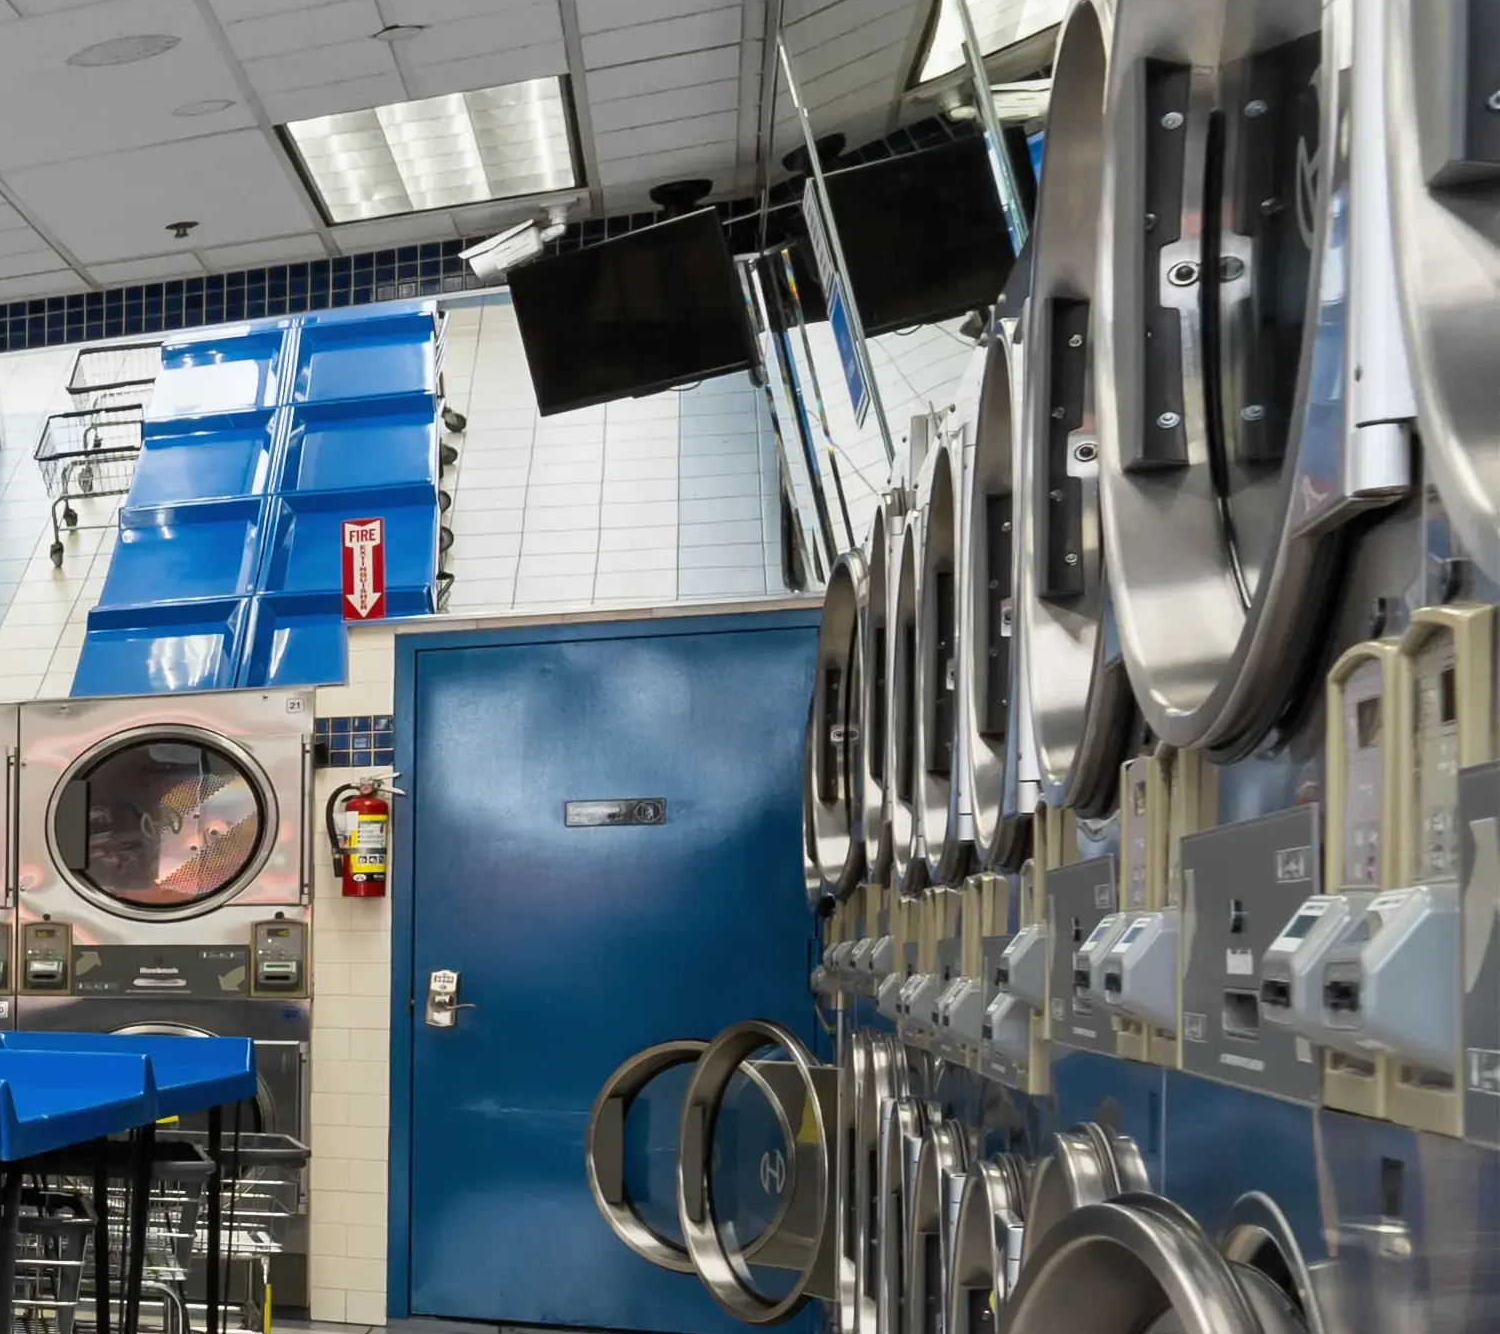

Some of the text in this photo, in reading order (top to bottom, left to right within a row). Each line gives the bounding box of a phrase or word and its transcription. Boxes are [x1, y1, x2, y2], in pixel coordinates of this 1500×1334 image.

[348, 528, 376, 543] FIRE
[359, 544, 368, 610] EXTINGUISHER
[289, 700, 300, 710] 21
